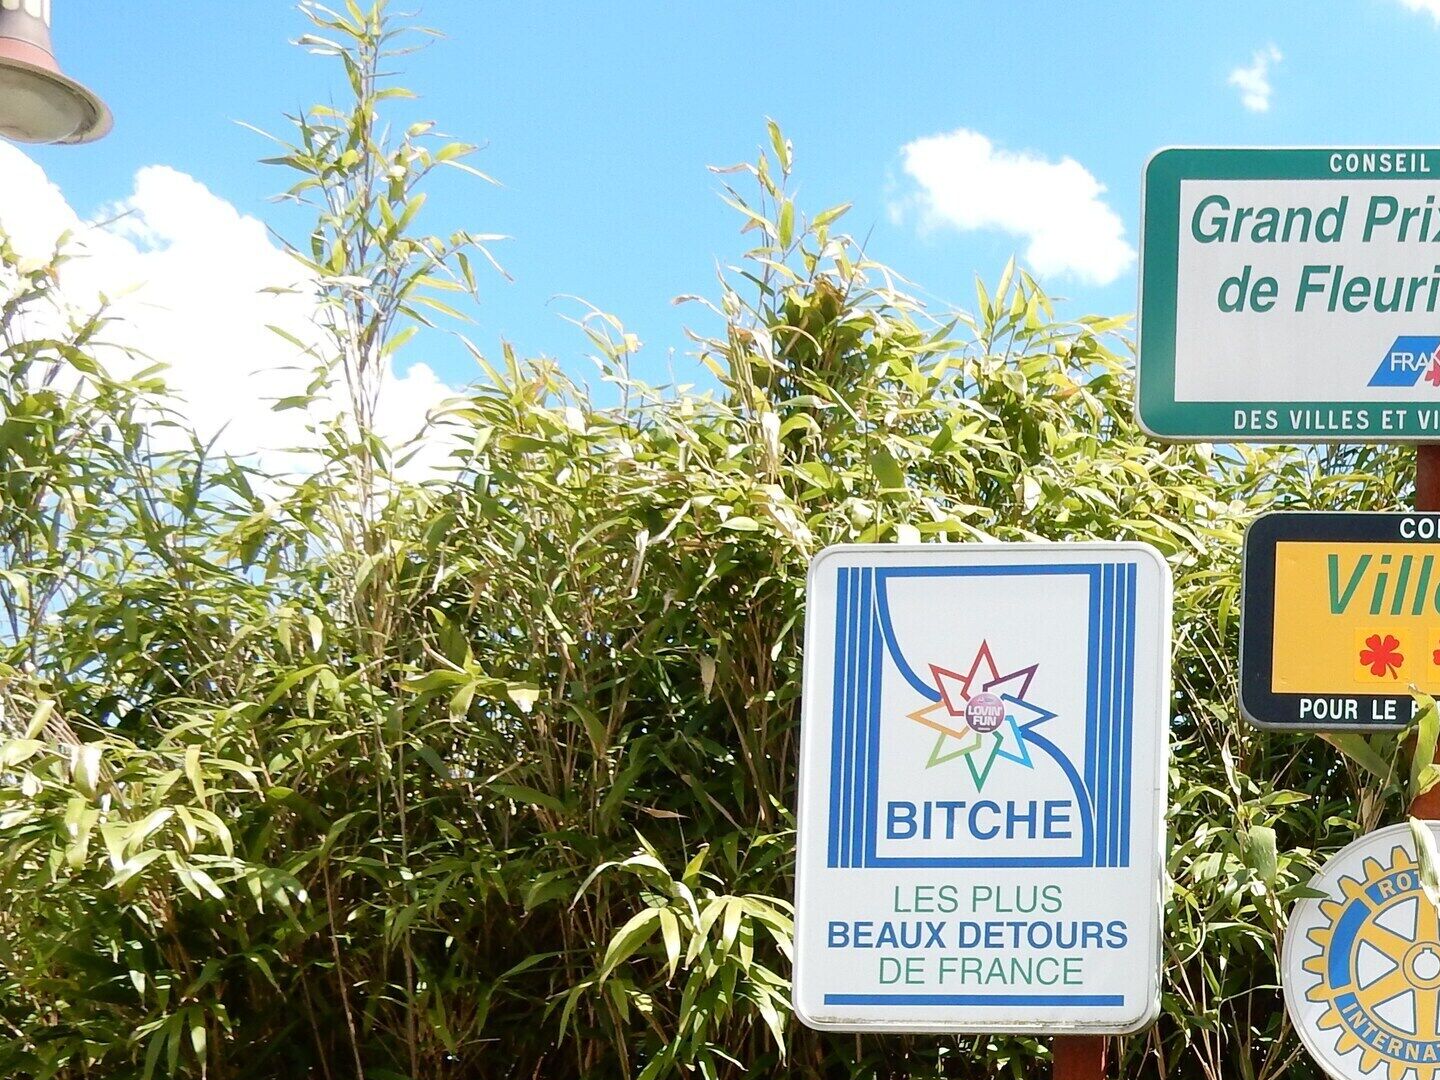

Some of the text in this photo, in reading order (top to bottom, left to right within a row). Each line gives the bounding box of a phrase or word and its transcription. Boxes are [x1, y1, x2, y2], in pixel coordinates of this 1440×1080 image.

[1329, 152, 1431, 173] CONSEIL
[1191, 195, 1348, 243] Grand
[1217, 265, 1278, 313] de
[1233, 410, 1278, 430] DES
[1289, 410, 1370, 430] VILLES
[1381, 410, 1407, 430] ET
[972, 715, 997, 727] FUN
[1299, 698, 1358, 720] POUR
[1371, 699, 1397, 720] LE
[886, 801, 1072, 840] BITCHE
[893, 884, 1063, 913] LES PLUS
[827, 921, 1128, 949] BEAUX DETOURS
[879, 957, 1084, 985] DE FRANCE
